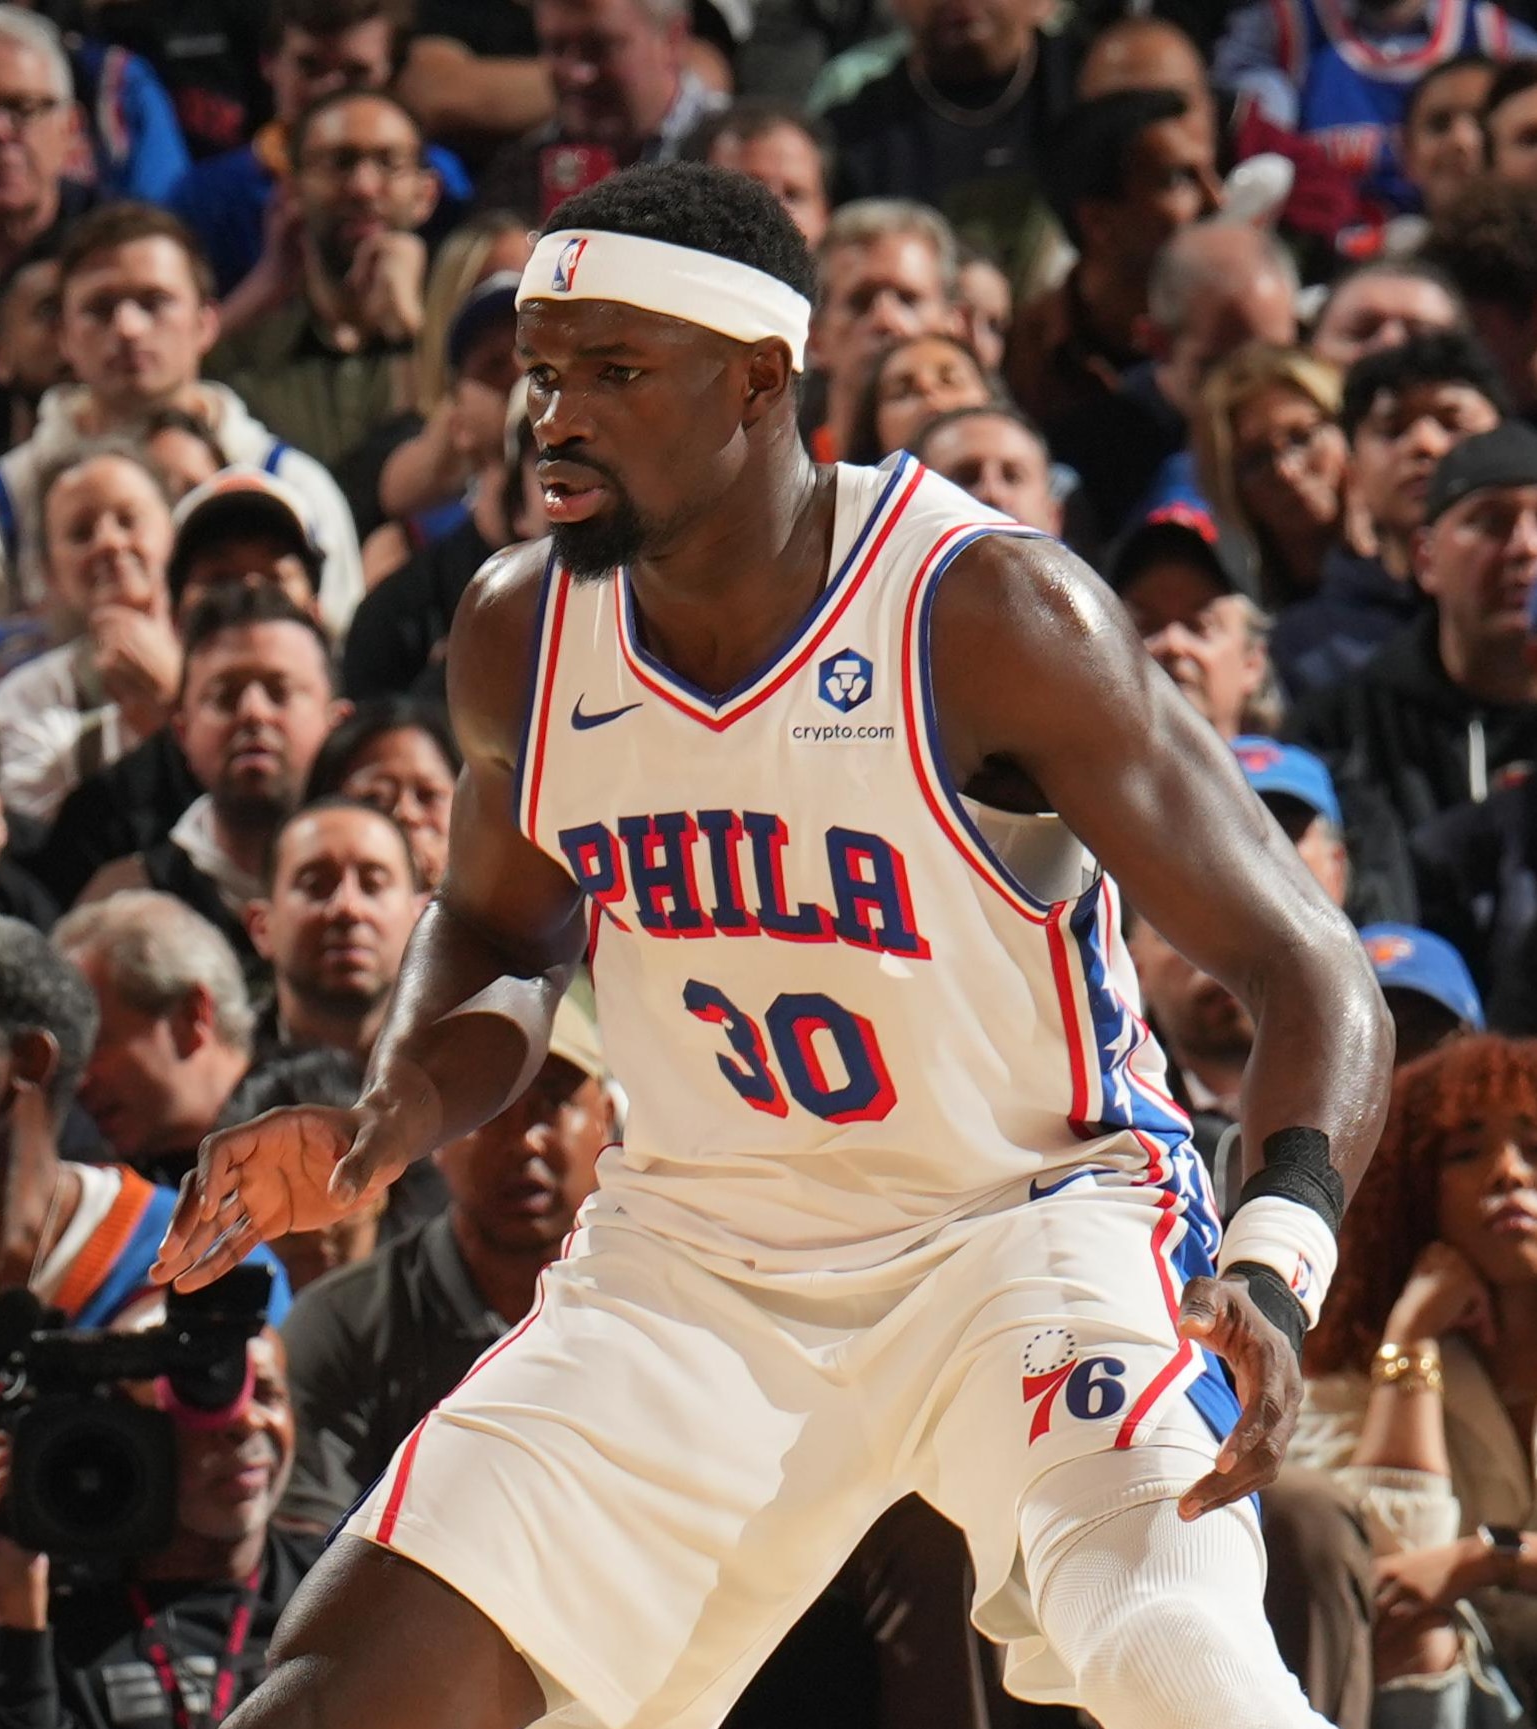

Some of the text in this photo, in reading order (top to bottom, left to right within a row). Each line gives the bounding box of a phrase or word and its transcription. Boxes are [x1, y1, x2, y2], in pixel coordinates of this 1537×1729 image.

[792, 723, 895, 742] crypto.com
[558, 809, 932, 960] PHILA
[682, 978, 898, 1125] 30
[1022, 1356, 1126, 1448] 76
